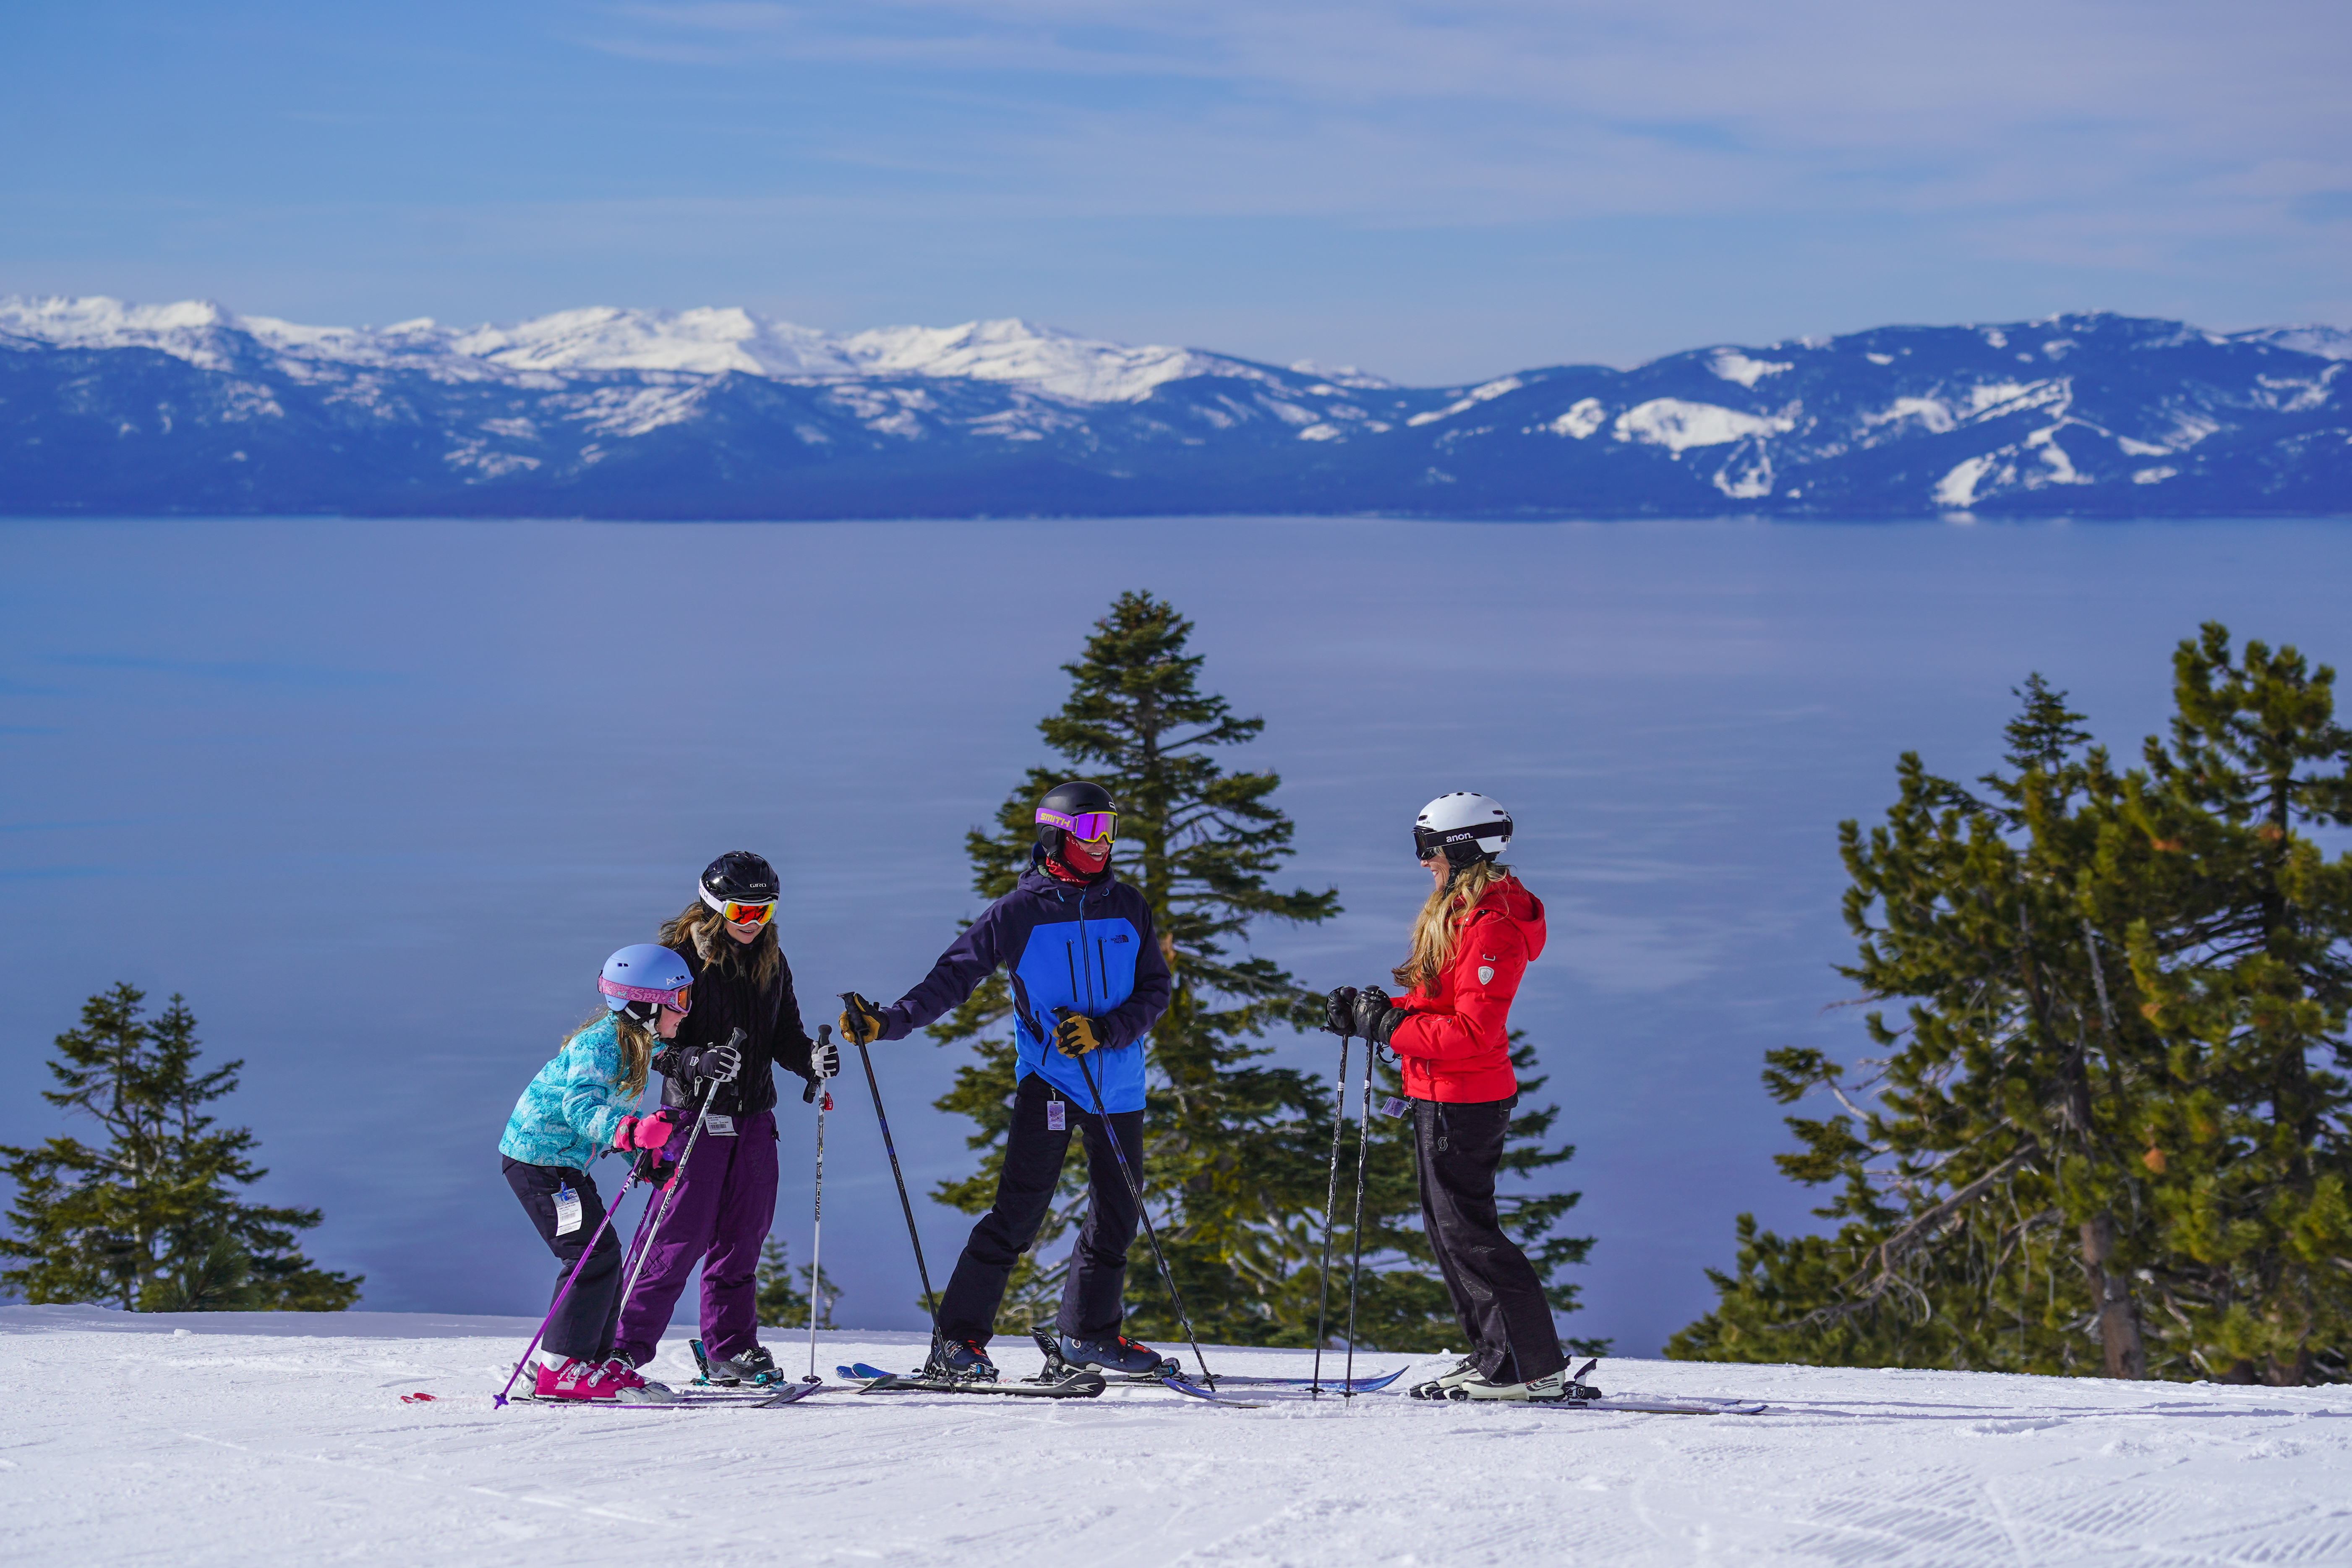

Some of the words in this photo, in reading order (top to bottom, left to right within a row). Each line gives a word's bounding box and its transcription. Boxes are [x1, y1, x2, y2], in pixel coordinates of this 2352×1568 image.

[1040, 813, 1071, 827] SMITH
[1446, 832, 1473, 843] anon.
[622, 1171, 637, 1193] LEKI
[592, 1216, 610, 1246] RIDER
